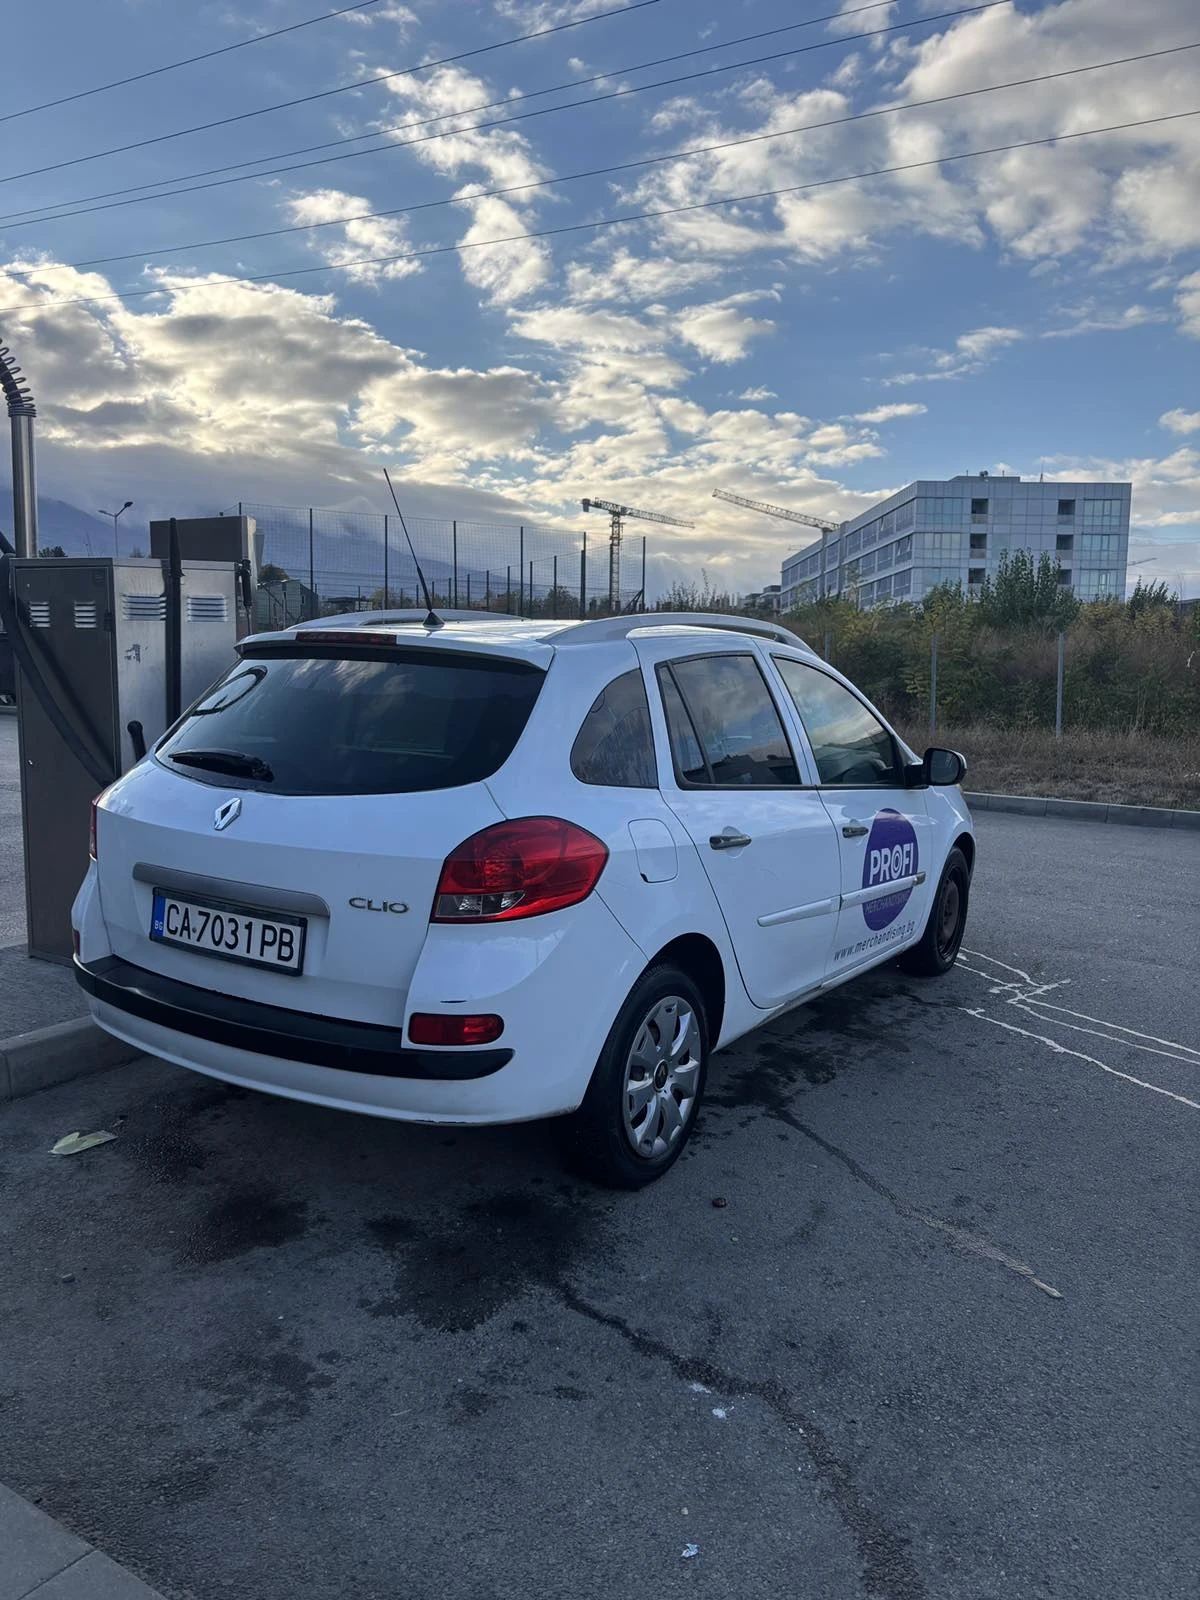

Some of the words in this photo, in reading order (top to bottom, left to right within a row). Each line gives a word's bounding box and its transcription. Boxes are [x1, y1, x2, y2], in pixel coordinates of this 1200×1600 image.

[869, 842, 914, 885] PROFI
[348, 897, 409, 914] CLIO
[154, 919, 163, 931] BG
[834, 921, 915, 961] www.merchandising.bg
